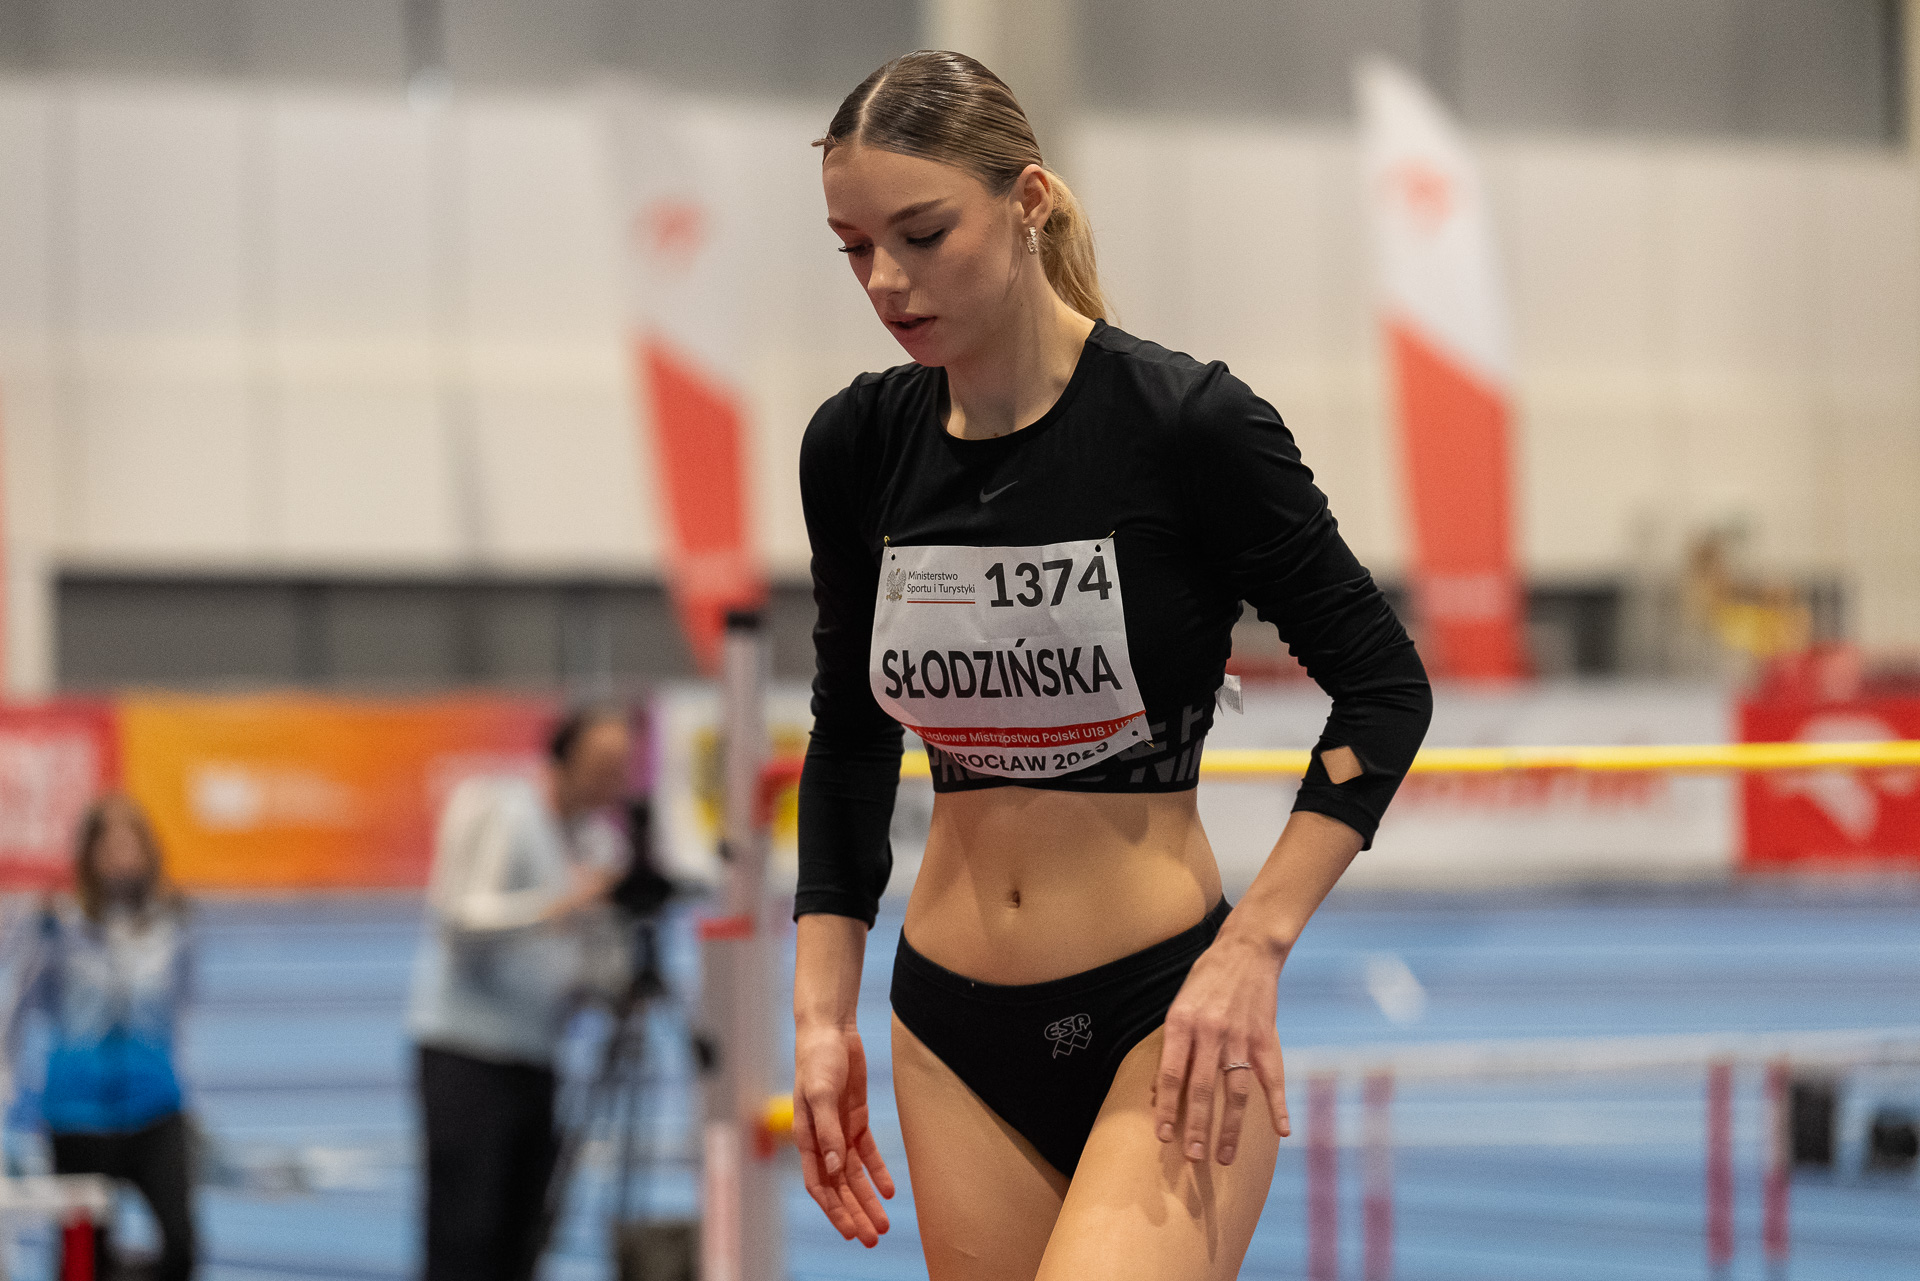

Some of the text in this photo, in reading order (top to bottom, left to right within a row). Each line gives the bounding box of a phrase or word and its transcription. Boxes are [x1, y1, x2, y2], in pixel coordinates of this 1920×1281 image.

[908, 571, 959, 581] Ministerstwo
[984, 555, 1113, 608] 1374
[906, 583, 976, 595] Sportu i Turystyki
[882, 638, 1123, 699] SŁODZIŃSKA
[924, 731, 967, 743] Halowe
[968, 731, 1040, 743] Mistrzostwa
[1042, 728, 1080, 743] Polski
[1082, 726, 1106, 738] U18
[1107, 724, 1113, 734] i
